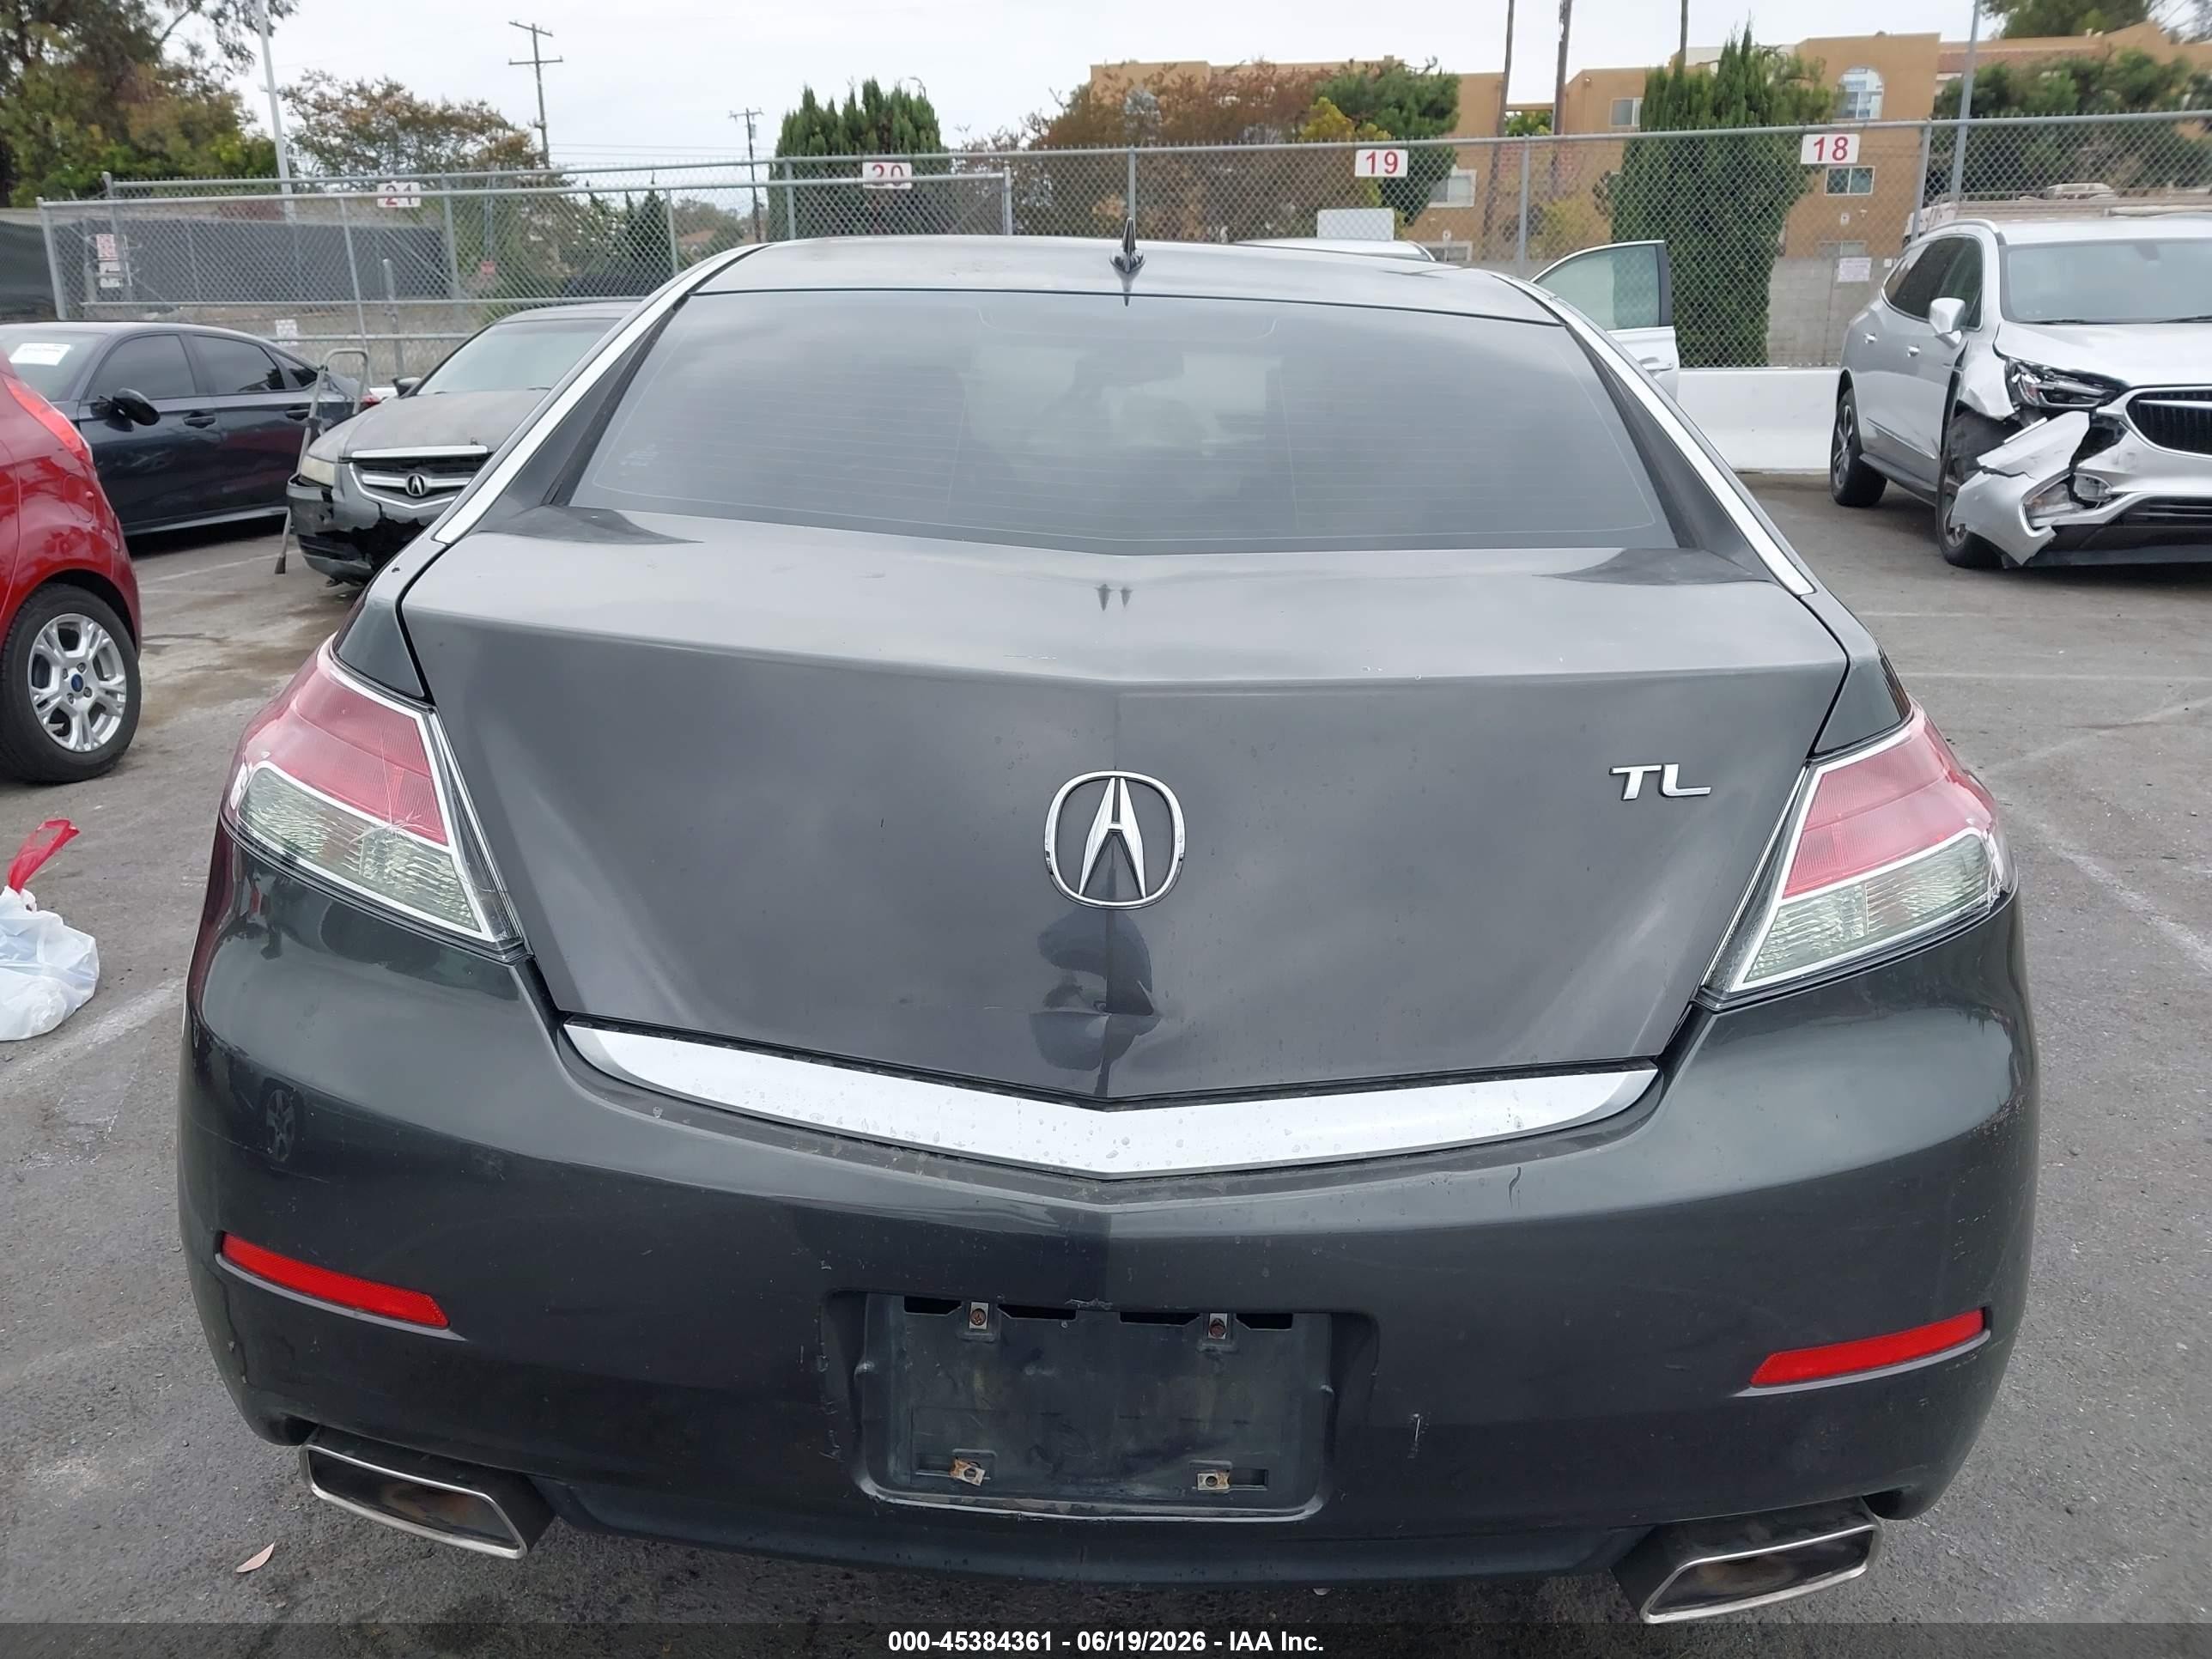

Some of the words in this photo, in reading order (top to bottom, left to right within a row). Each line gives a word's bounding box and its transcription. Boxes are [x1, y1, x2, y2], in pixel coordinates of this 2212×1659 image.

[1814, 137, 1848, 161] 18
[1366, 151, 1398, 174] 19
[872, 164, 903, 186] 20
[386, 184, 411, 205] 21
[1609, 763, 1711, 801] TL
